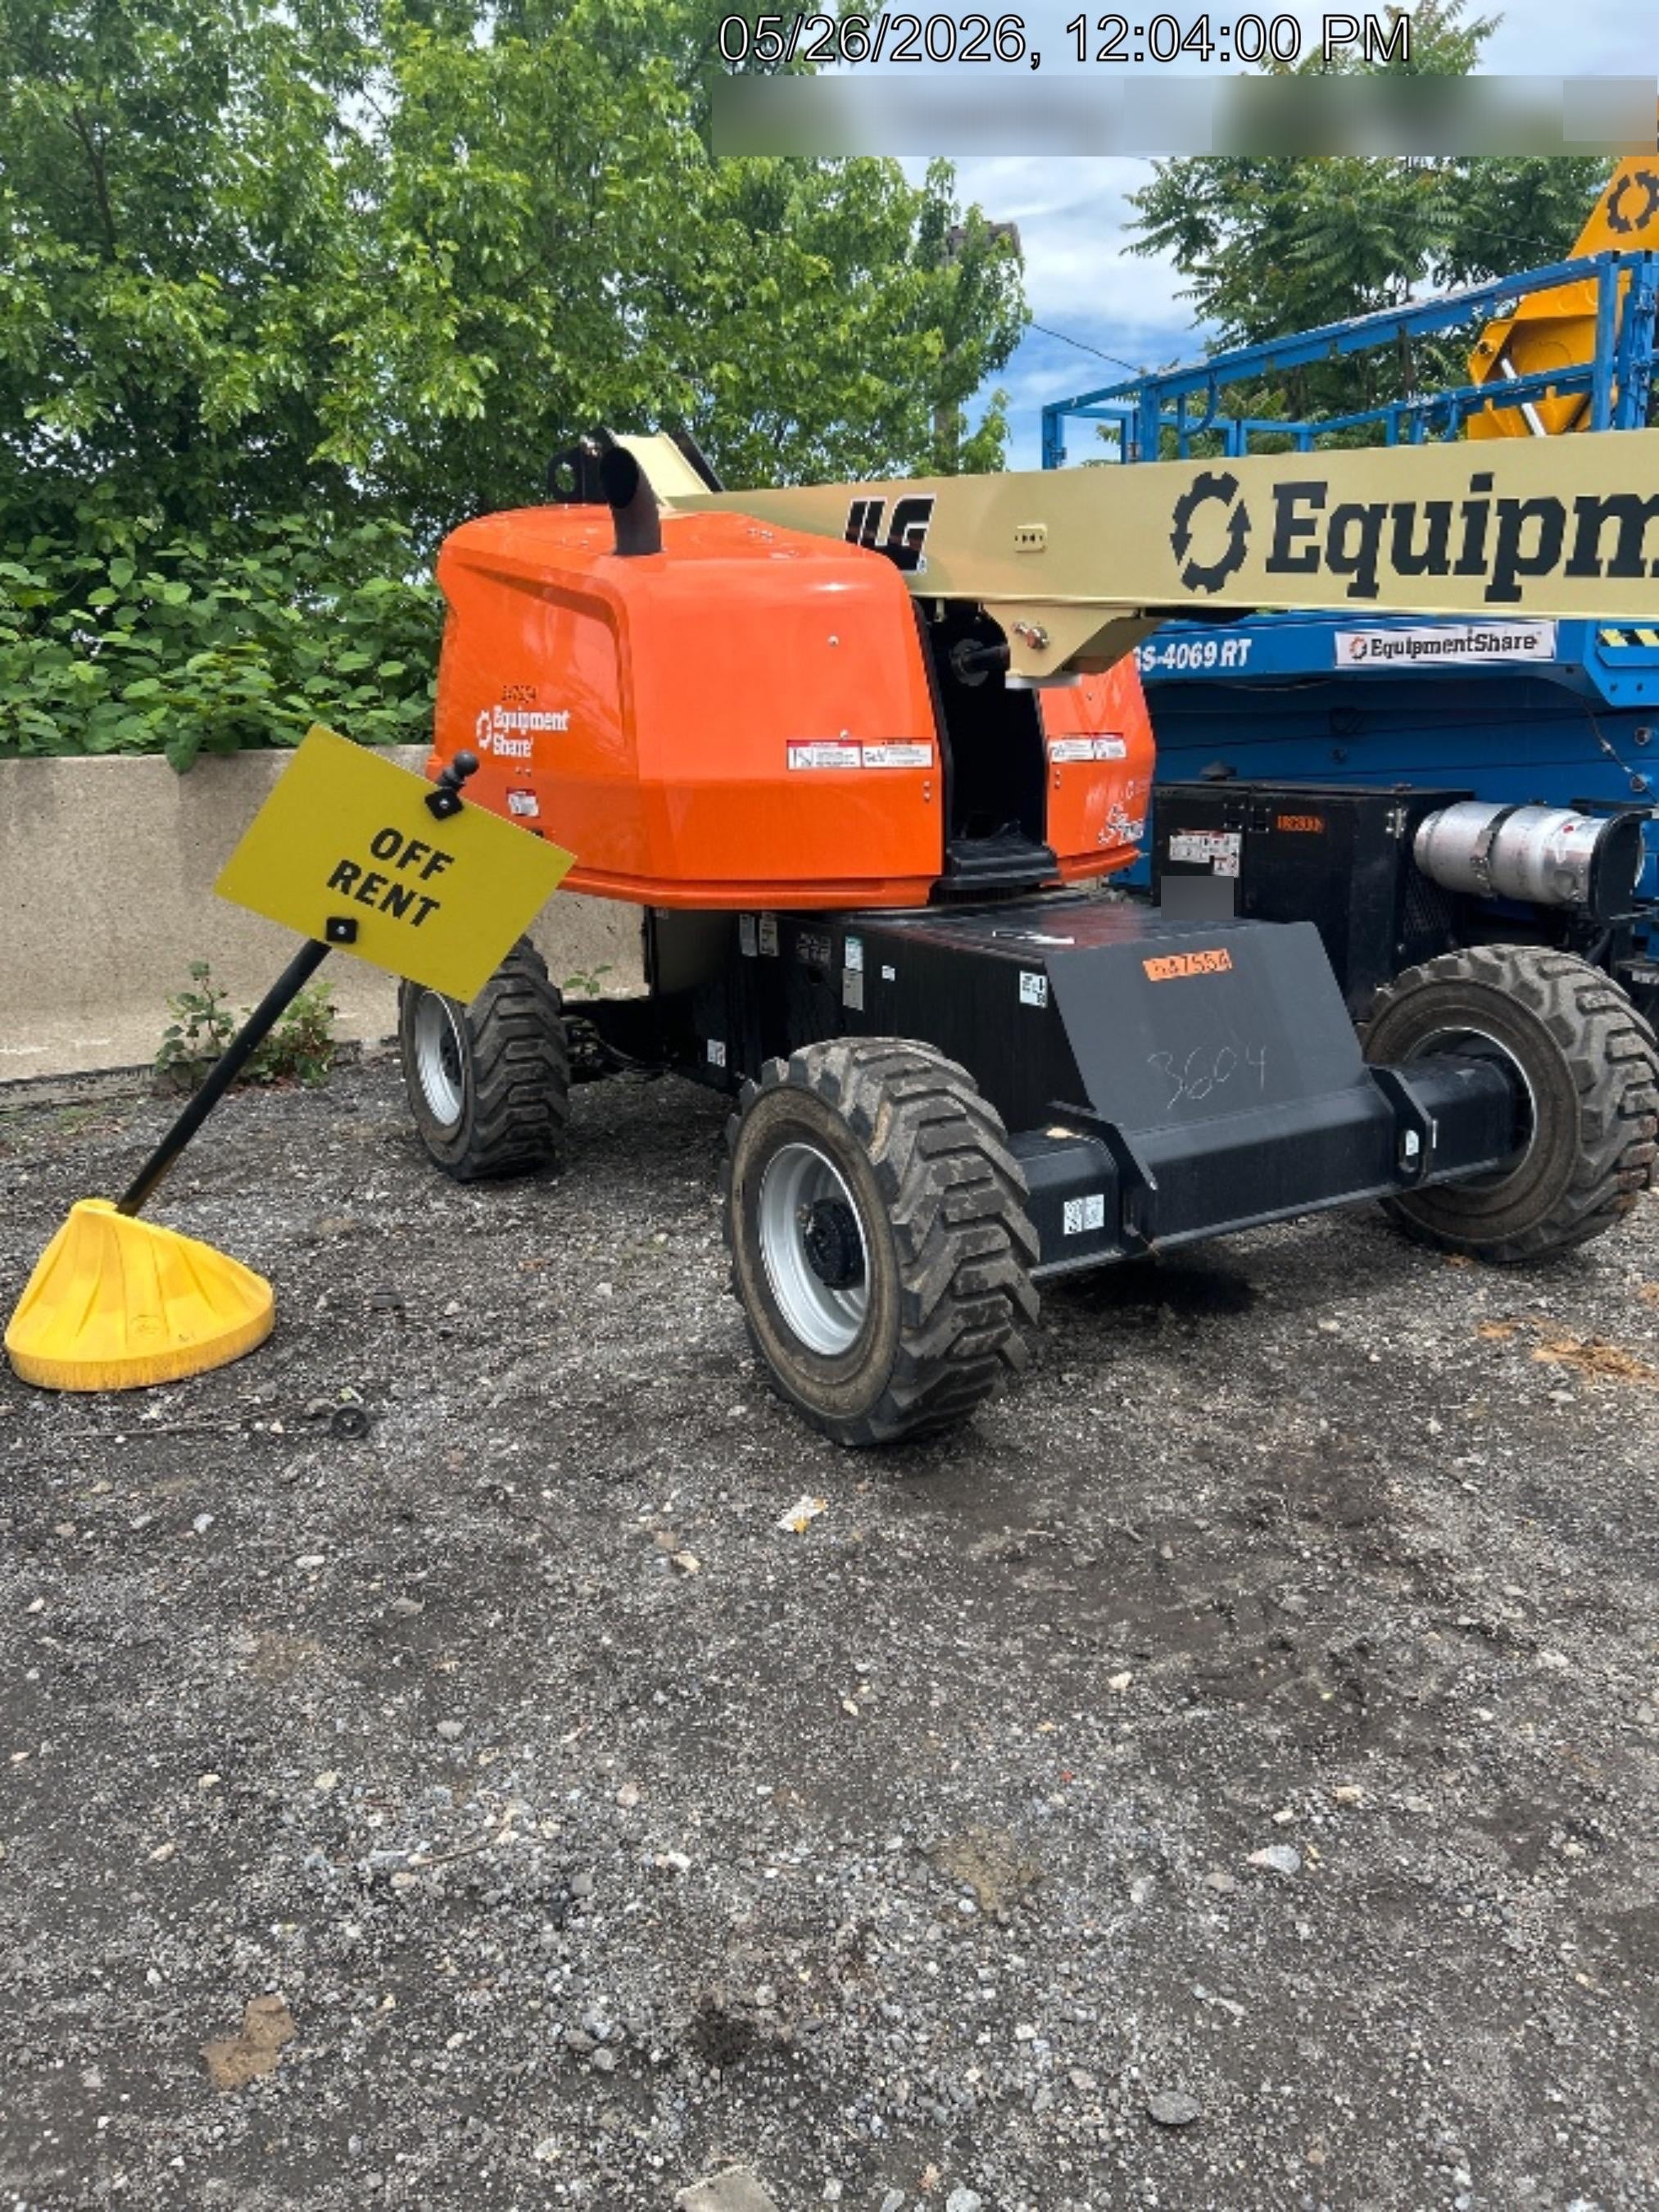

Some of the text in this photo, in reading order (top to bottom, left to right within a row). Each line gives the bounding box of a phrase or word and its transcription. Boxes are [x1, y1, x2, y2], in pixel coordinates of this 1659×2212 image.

[1219, 638, 1252, 667] RT
[1371, 625, 1538, 660] EquipmentShare
[492, 705, 570, 736] Equipment
[492, 732, 532, 758] Share
[370, 827, 456, 881] OFF
[327, 859, 441, 927] RENT
